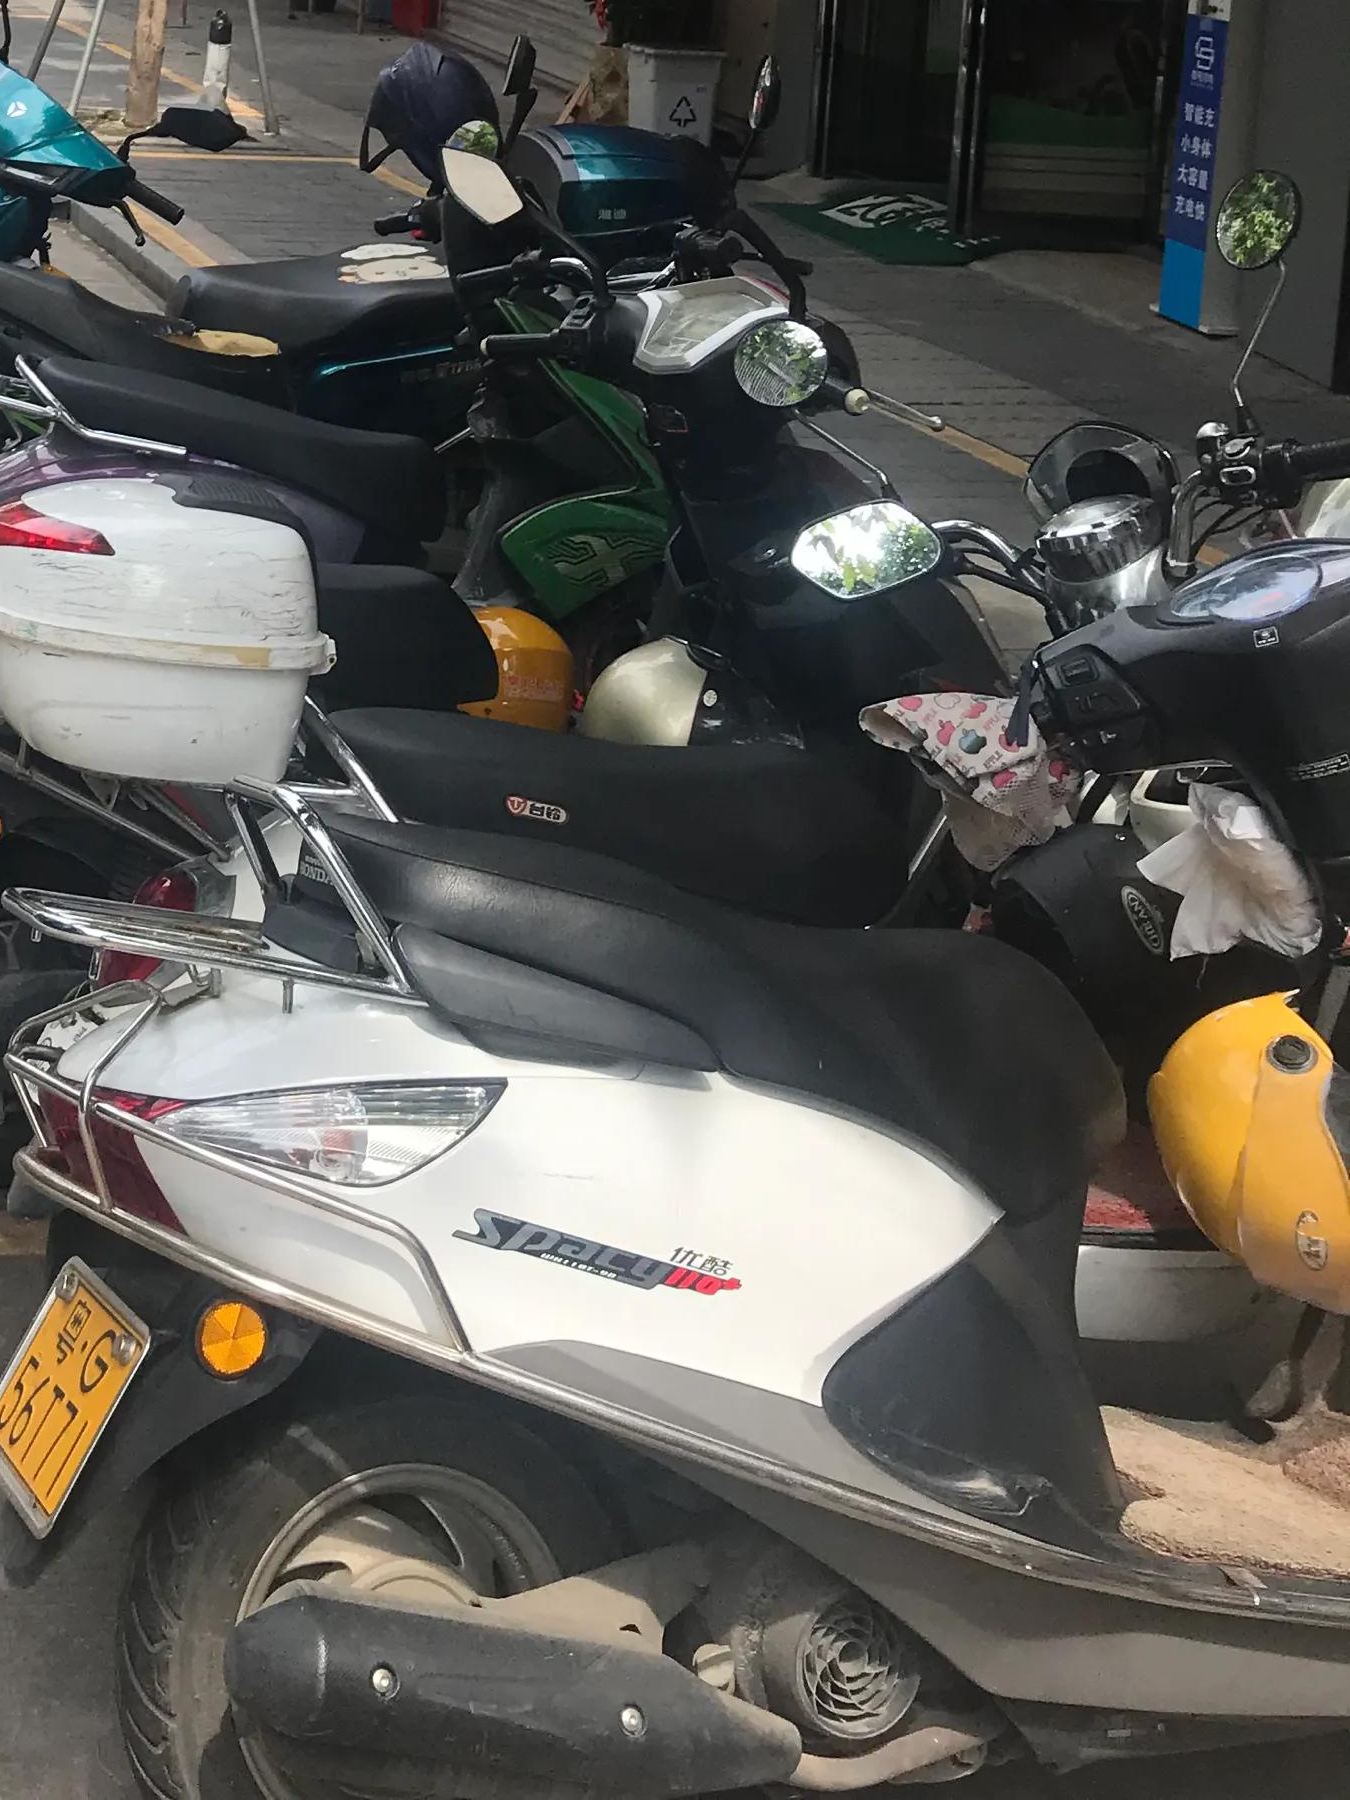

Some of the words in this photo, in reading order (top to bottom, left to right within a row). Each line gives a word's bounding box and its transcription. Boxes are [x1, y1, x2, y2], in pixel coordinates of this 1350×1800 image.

[1177, 163, 1209, 191] 大容量
[669, 1246, 733, 1276] 优酷
